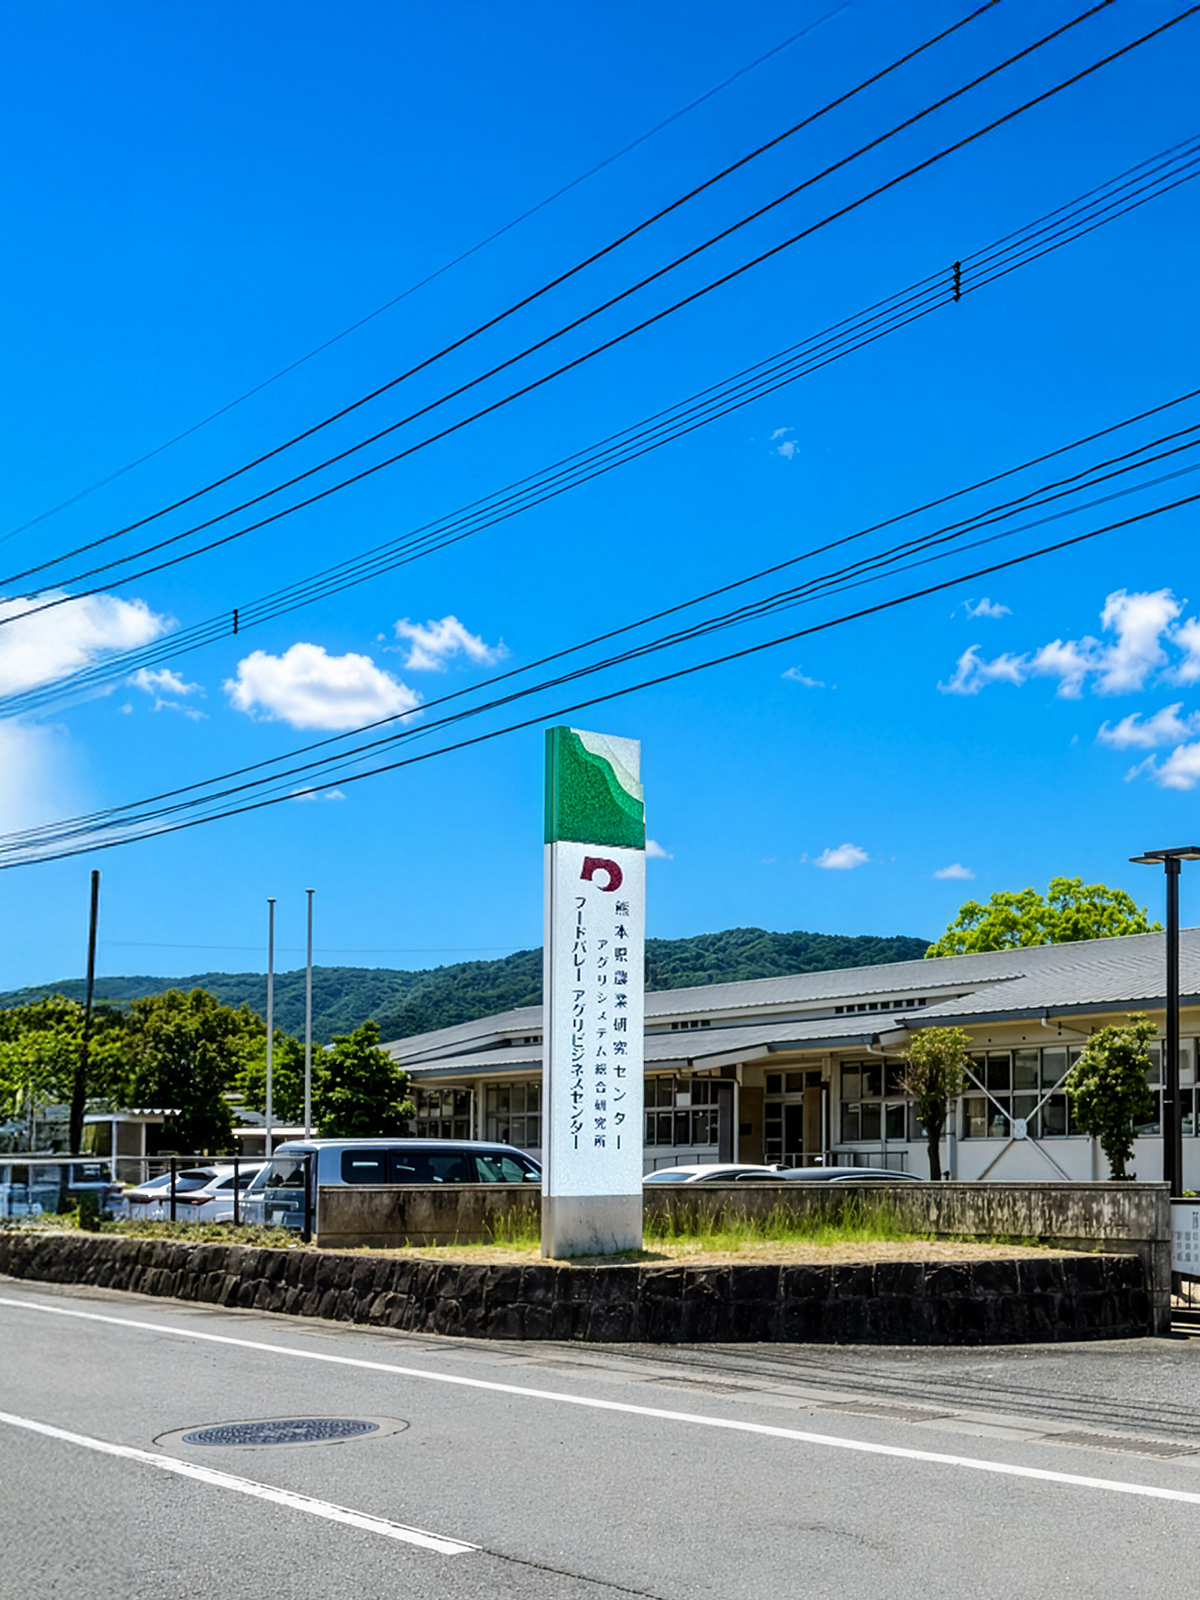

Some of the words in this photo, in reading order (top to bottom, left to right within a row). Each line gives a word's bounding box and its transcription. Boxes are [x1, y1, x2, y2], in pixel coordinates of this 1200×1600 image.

[571, 897, 587, 982] フードバレー
[570, 989, 585, 1150] アグリビジネスセンター
[613, 900, 629, 1150] 熊本県農業研究センター
